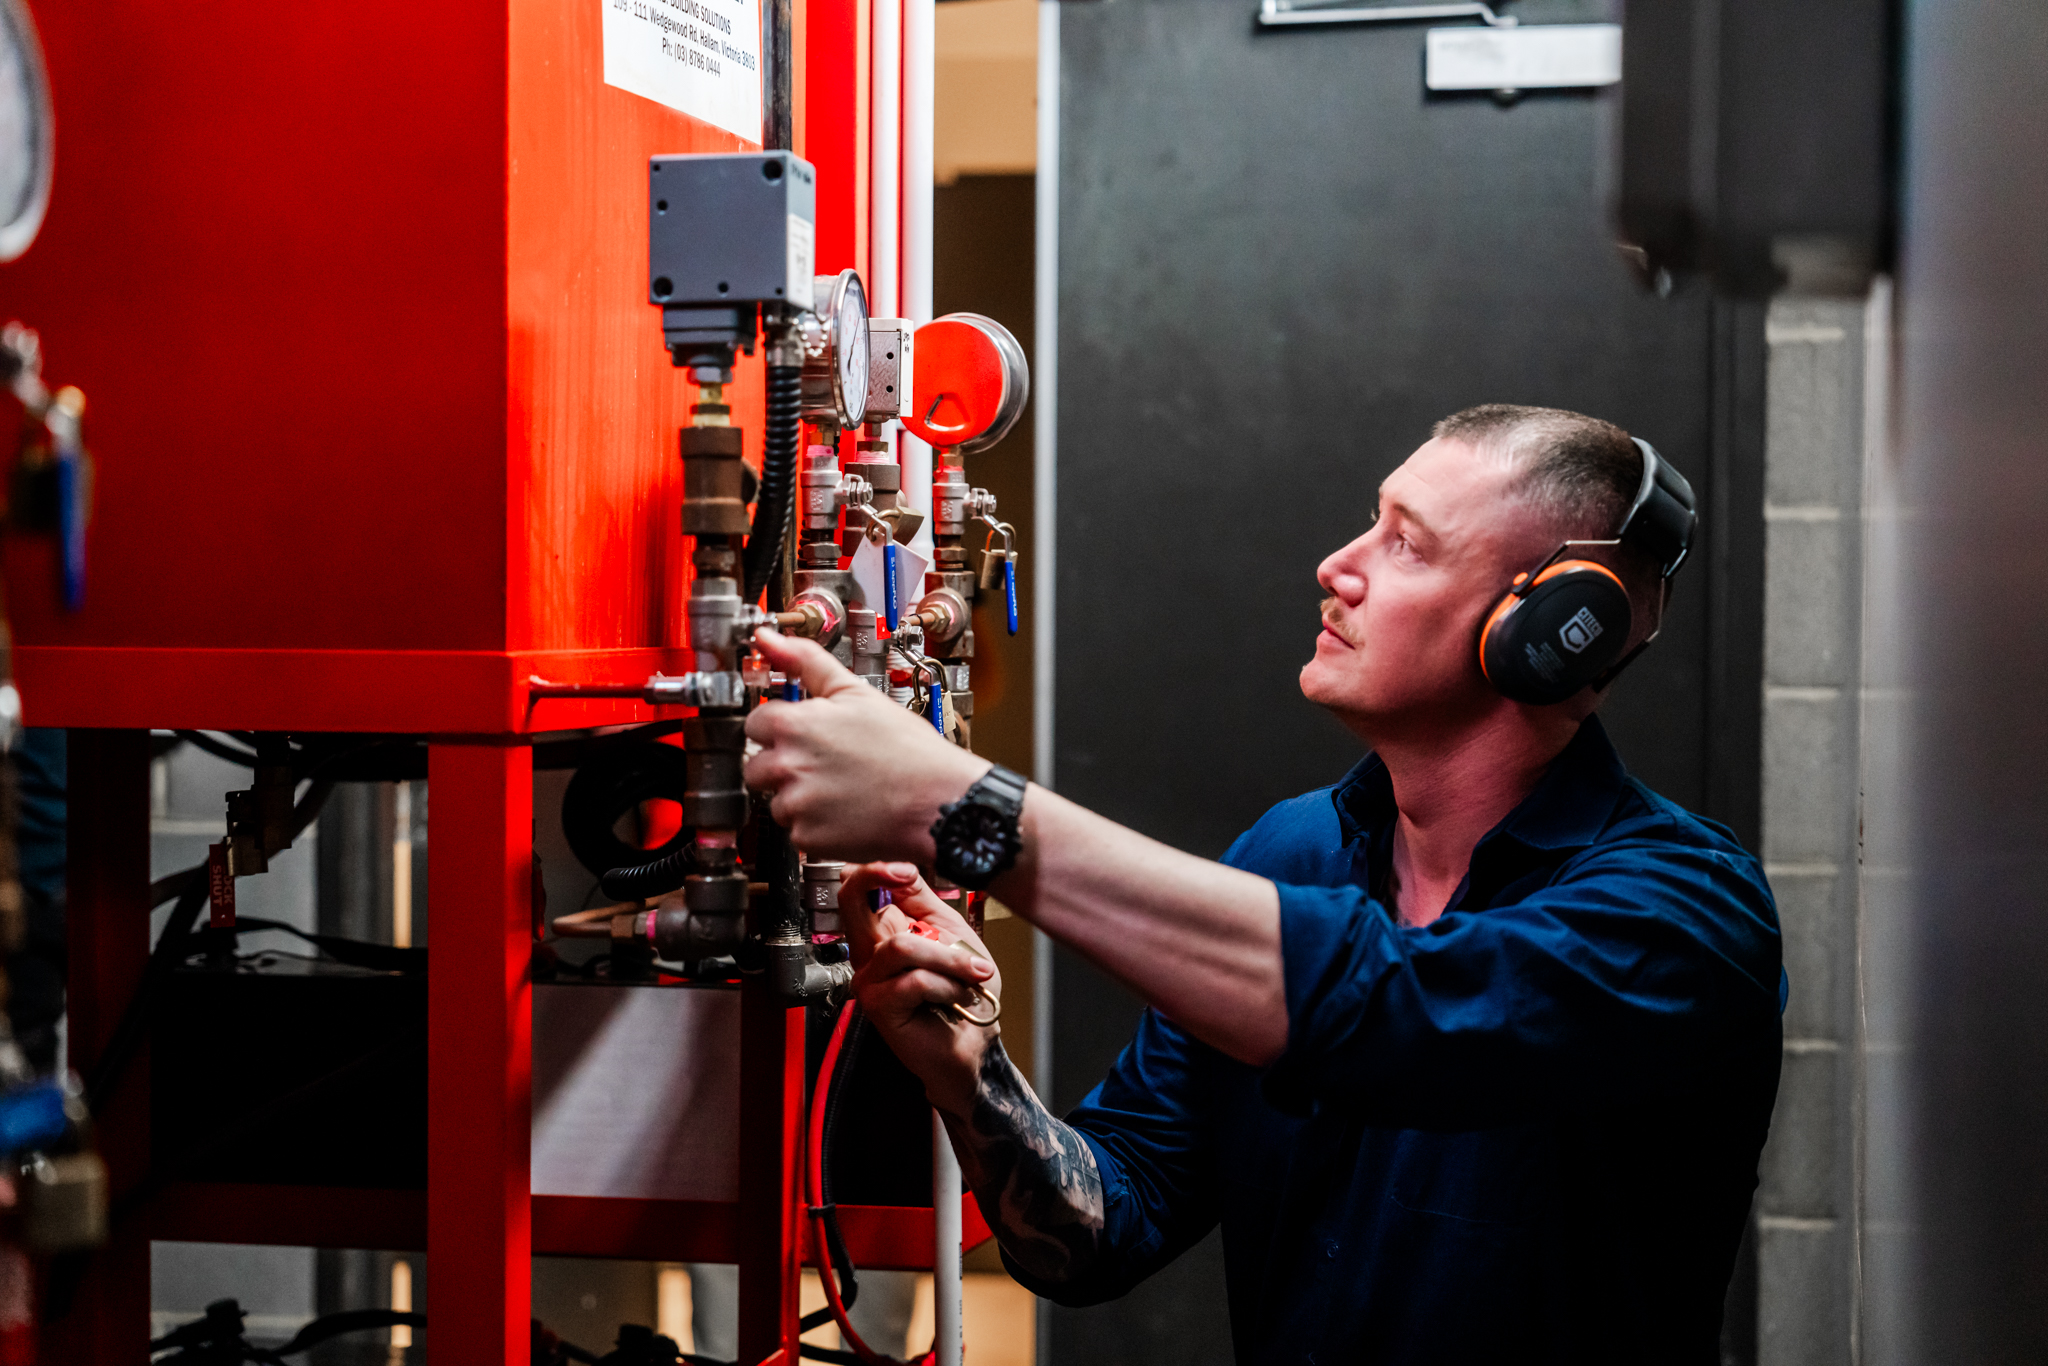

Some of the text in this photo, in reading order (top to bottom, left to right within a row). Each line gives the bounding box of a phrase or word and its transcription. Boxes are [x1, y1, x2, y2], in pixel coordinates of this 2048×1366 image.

[634, 1, 648, 21] 111
[650, 6, 687, 38] Wedgewood
[721, 40, 741, 64] Victoria
[700, 5, 731, 35] SOLUTIONS
[662, 37, 673, 56] Ph:
[674, 42, 688, 67] (03)
[689, 49, 704, 70] 8786
[212, 865, 223, 907] SHUT
[223, 872, 233, 905] OCK
